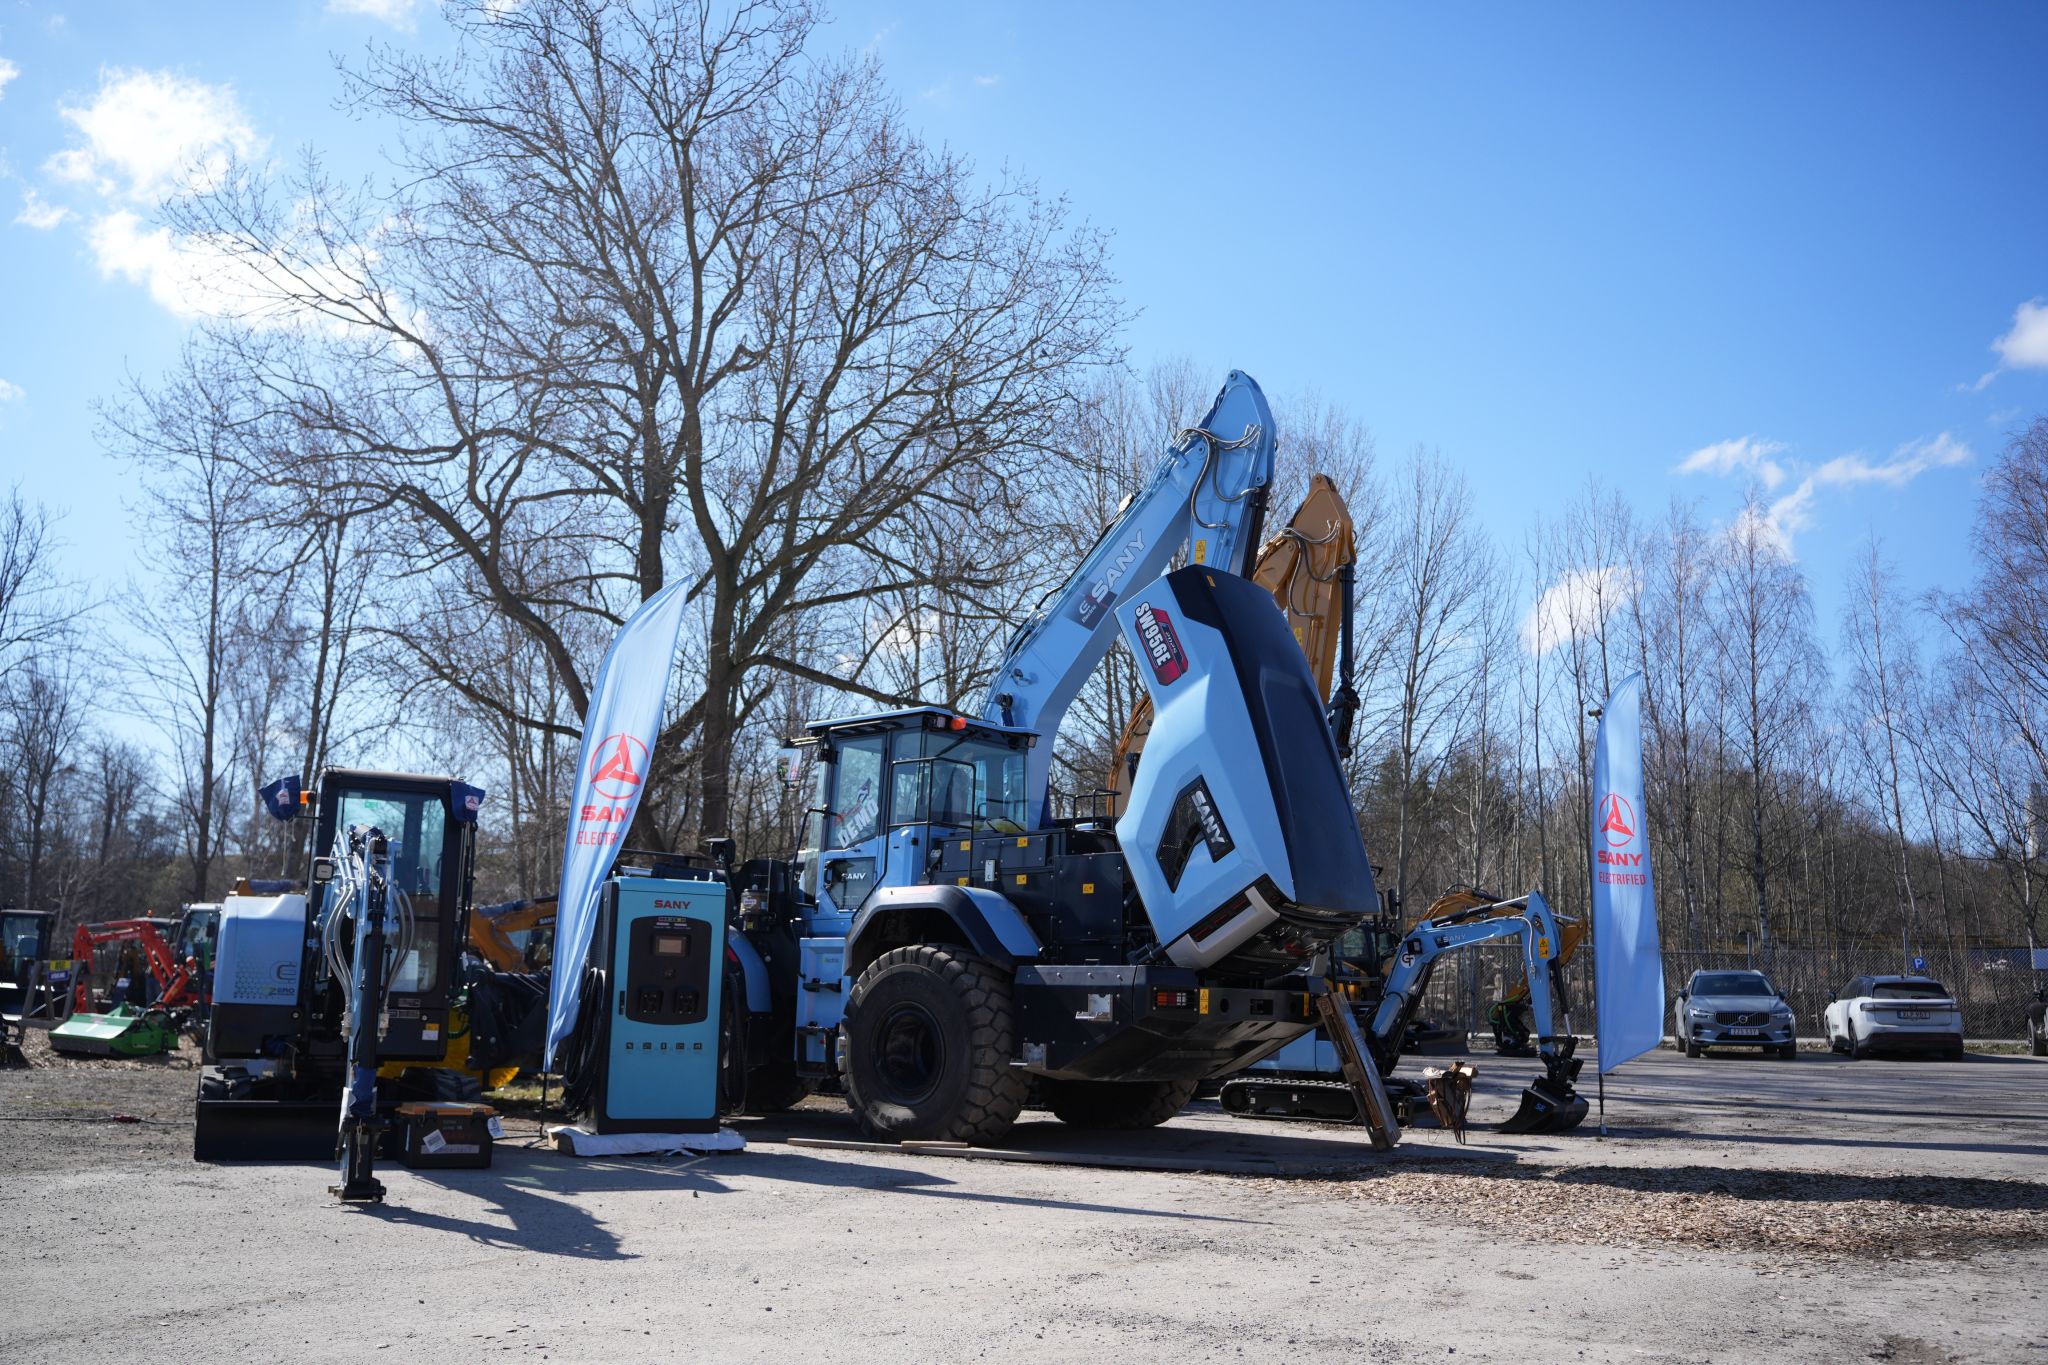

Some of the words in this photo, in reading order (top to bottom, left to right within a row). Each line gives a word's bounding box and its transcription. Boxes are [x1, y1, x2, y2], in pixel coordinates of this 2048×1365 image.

[1091, 529, 1145, 603] SANY
[1135, 602, 1172, 667] SW956E
[580, 805, 632, 822] SAN
[1191, 790, 1226, 844] SANY
[838, 799, 879, 849] DEMO
[576, 830, 621, 846] ELECTR
[1597, 850, 1643, 866] SANY
[1598, 871, 1647, 886] ELECTRIFIED
[654, 899, 691, 910] SANY
[1914, 958, 1924, 969] P
